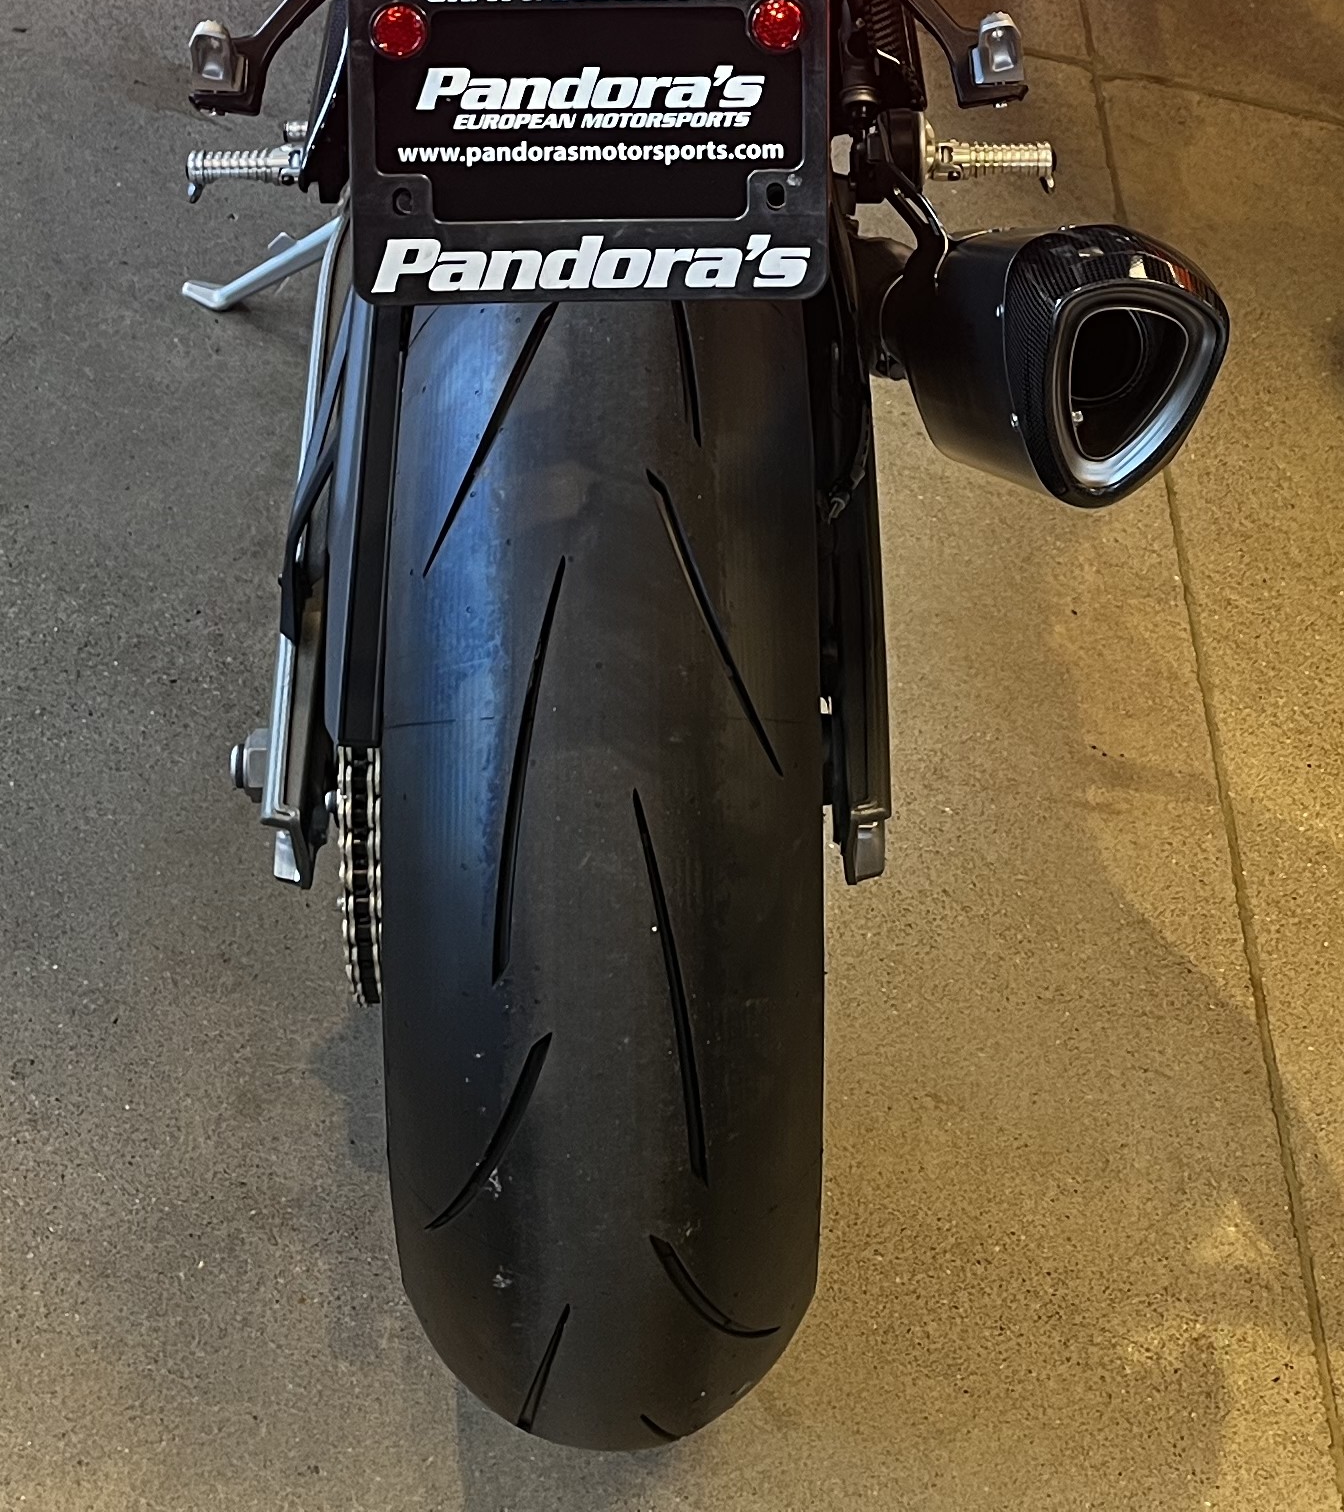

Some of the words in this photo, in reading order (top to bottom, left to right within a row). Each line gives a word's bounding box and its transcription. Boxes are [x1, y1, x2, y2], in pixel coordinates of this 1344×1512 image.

[415, 64, 766, 111] Pandora's
[453, 113, 577, 130] EUROPEAN
[580, 111, 752, 129] MOTORSPORTS
[397, 140, 785, 167] www.pandorasmotorsports.com
[370, 233, 812, 294] Pandora's
